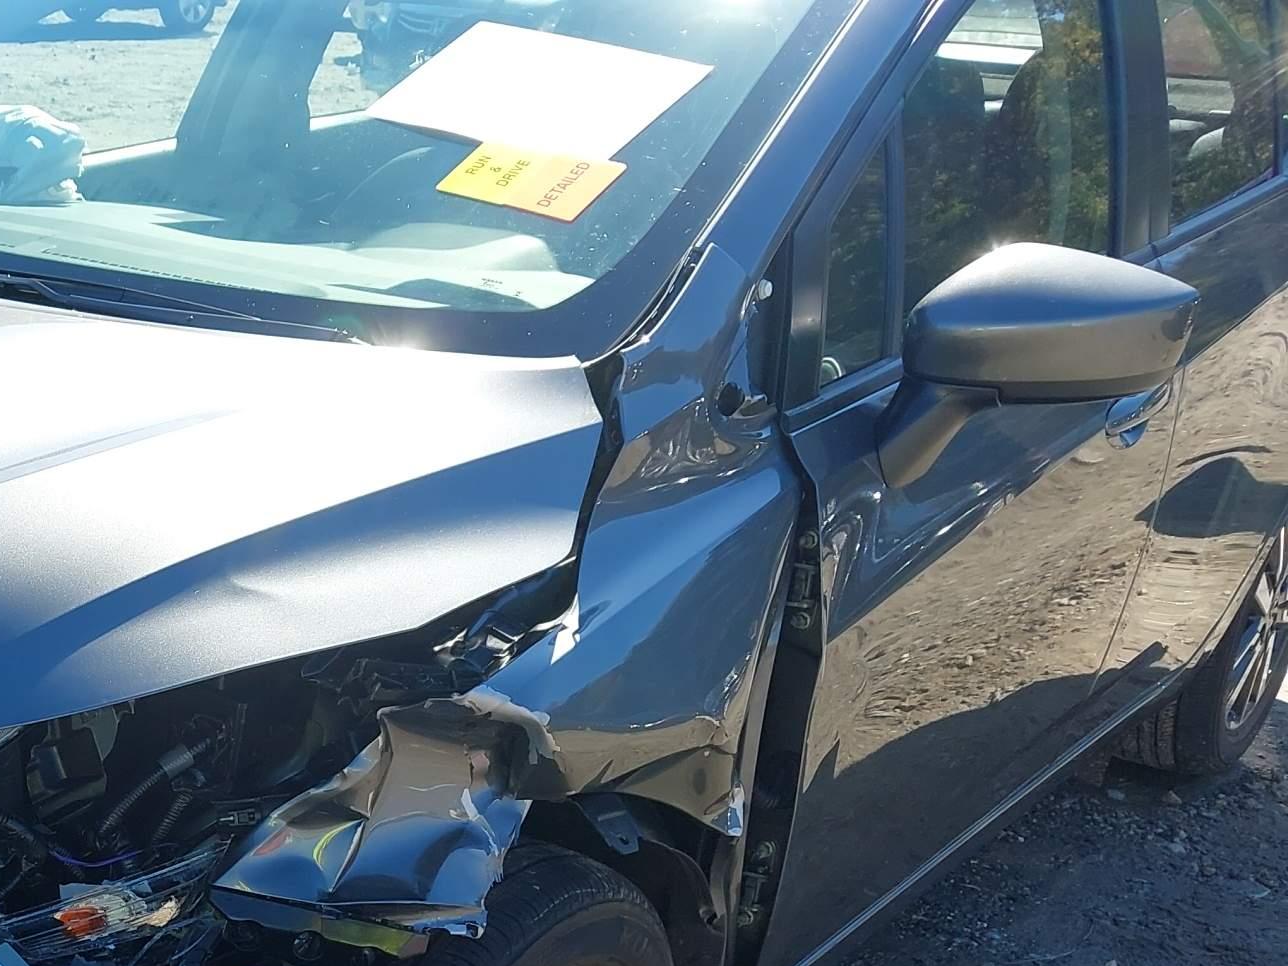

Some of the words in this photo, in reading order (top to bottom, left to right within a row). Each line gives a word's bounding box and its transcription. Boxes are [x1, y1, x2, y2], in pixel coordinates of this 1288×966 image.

[466, 156, 492, 175] RUN
[496, 160, 530, 187] DRIVE
[537, 162, 590, 207] DETAILED
